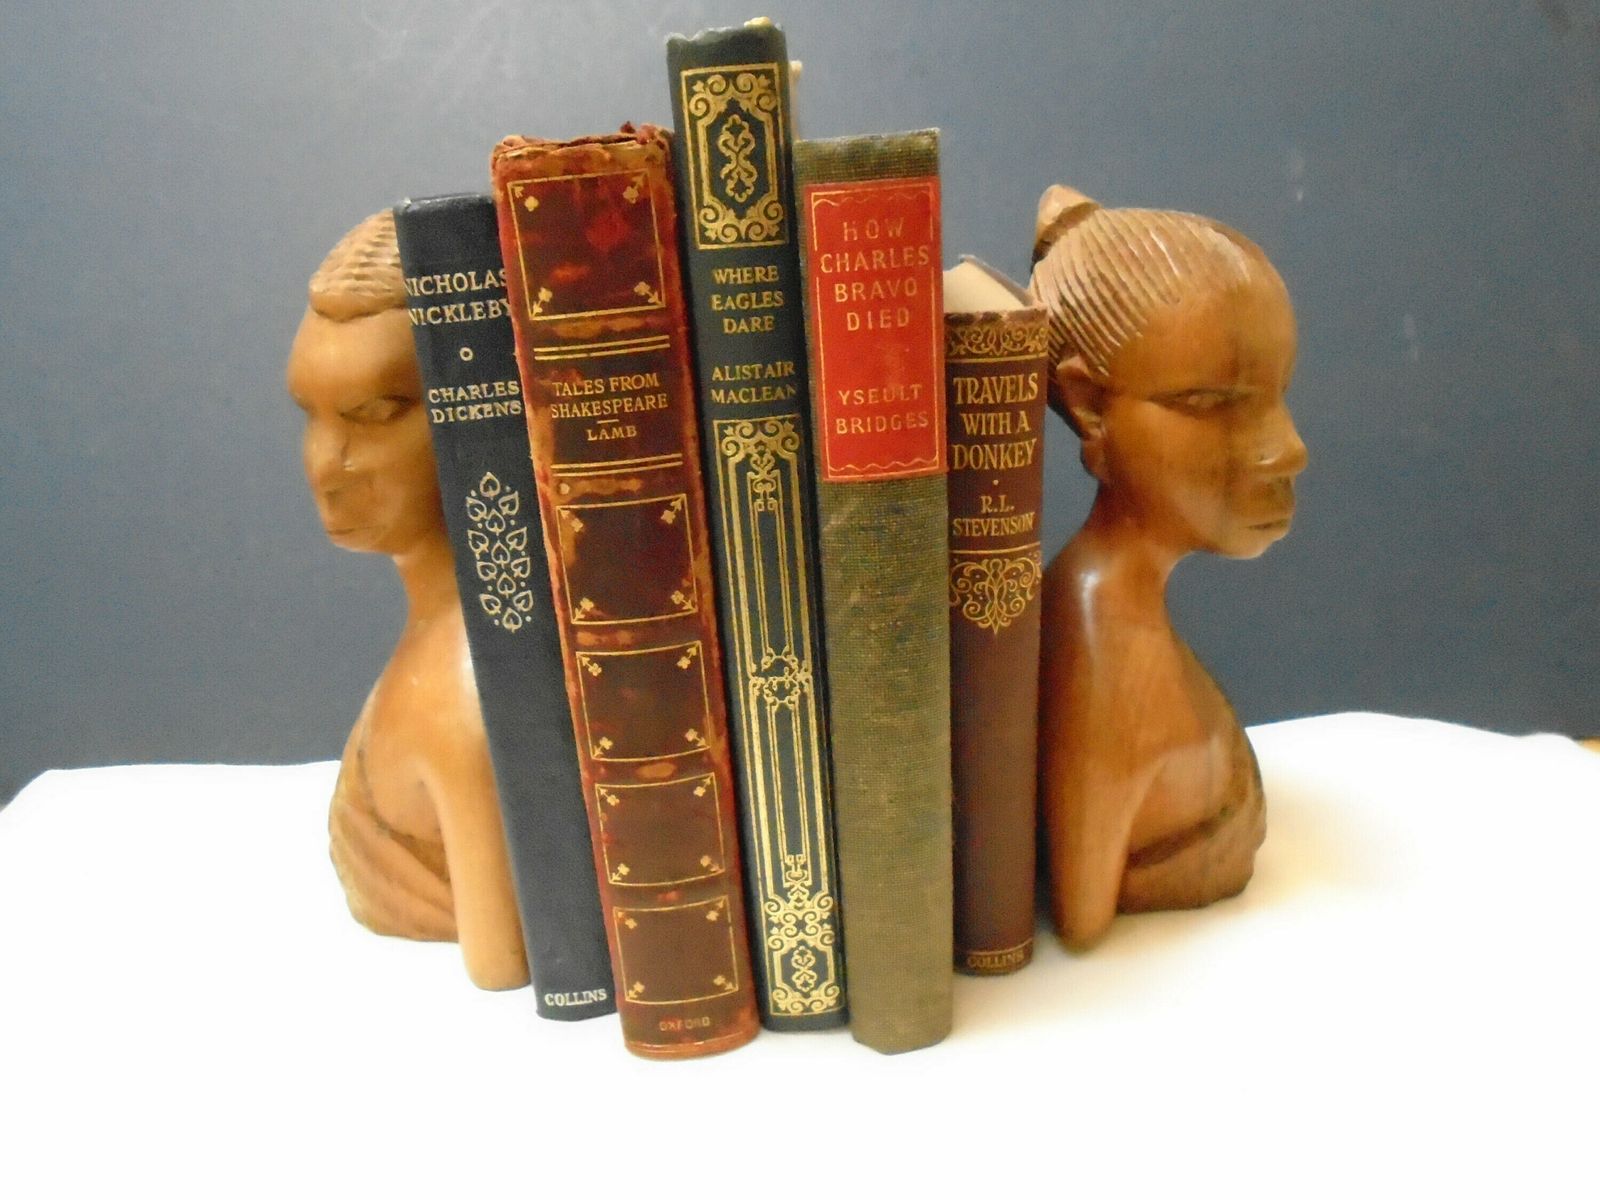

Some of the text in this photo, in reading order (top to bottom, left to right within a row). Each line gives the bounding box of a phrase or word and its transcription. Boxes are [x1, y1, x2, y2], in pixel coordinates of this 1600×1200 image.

[843, 217, 905, 241] HOW
[821, 245, 930, 273] CHARLES
[712, 265, 780, 285] WHERE
[711, 290, 785, 311] EAGLES
[834, 277, 918, 302] BRAVO
[722, 315, 776, 335] DARE
[846, 307, 910, 331] DIED
[711, 361, 796, 381] ALISTAIR
[428, 380, 520, 403] CHARLES
[551, 372, 660, 397] TALES FROM
[711, 384, 798, 404] MACLEAN
[838, 383, 923, 406] YSEULT
[953, 372, 1039, 405] TRAVELS
[431, 400, 523, 424] DICKENS
[550, 393, 669, 419] SHAKESPEARE
[586, 425, 638, 441] LAMB
[836, 411, 930, 435] BRIDGES
[960, 410, 1032, 436] WITH A
[952, 438, 1038, 470] DONKEY
[952, 511, 1036, 537] STEVENSON
[967, 950, 1024, 968] COLLINS
[544, 988, 608, 1007] COLLINS
